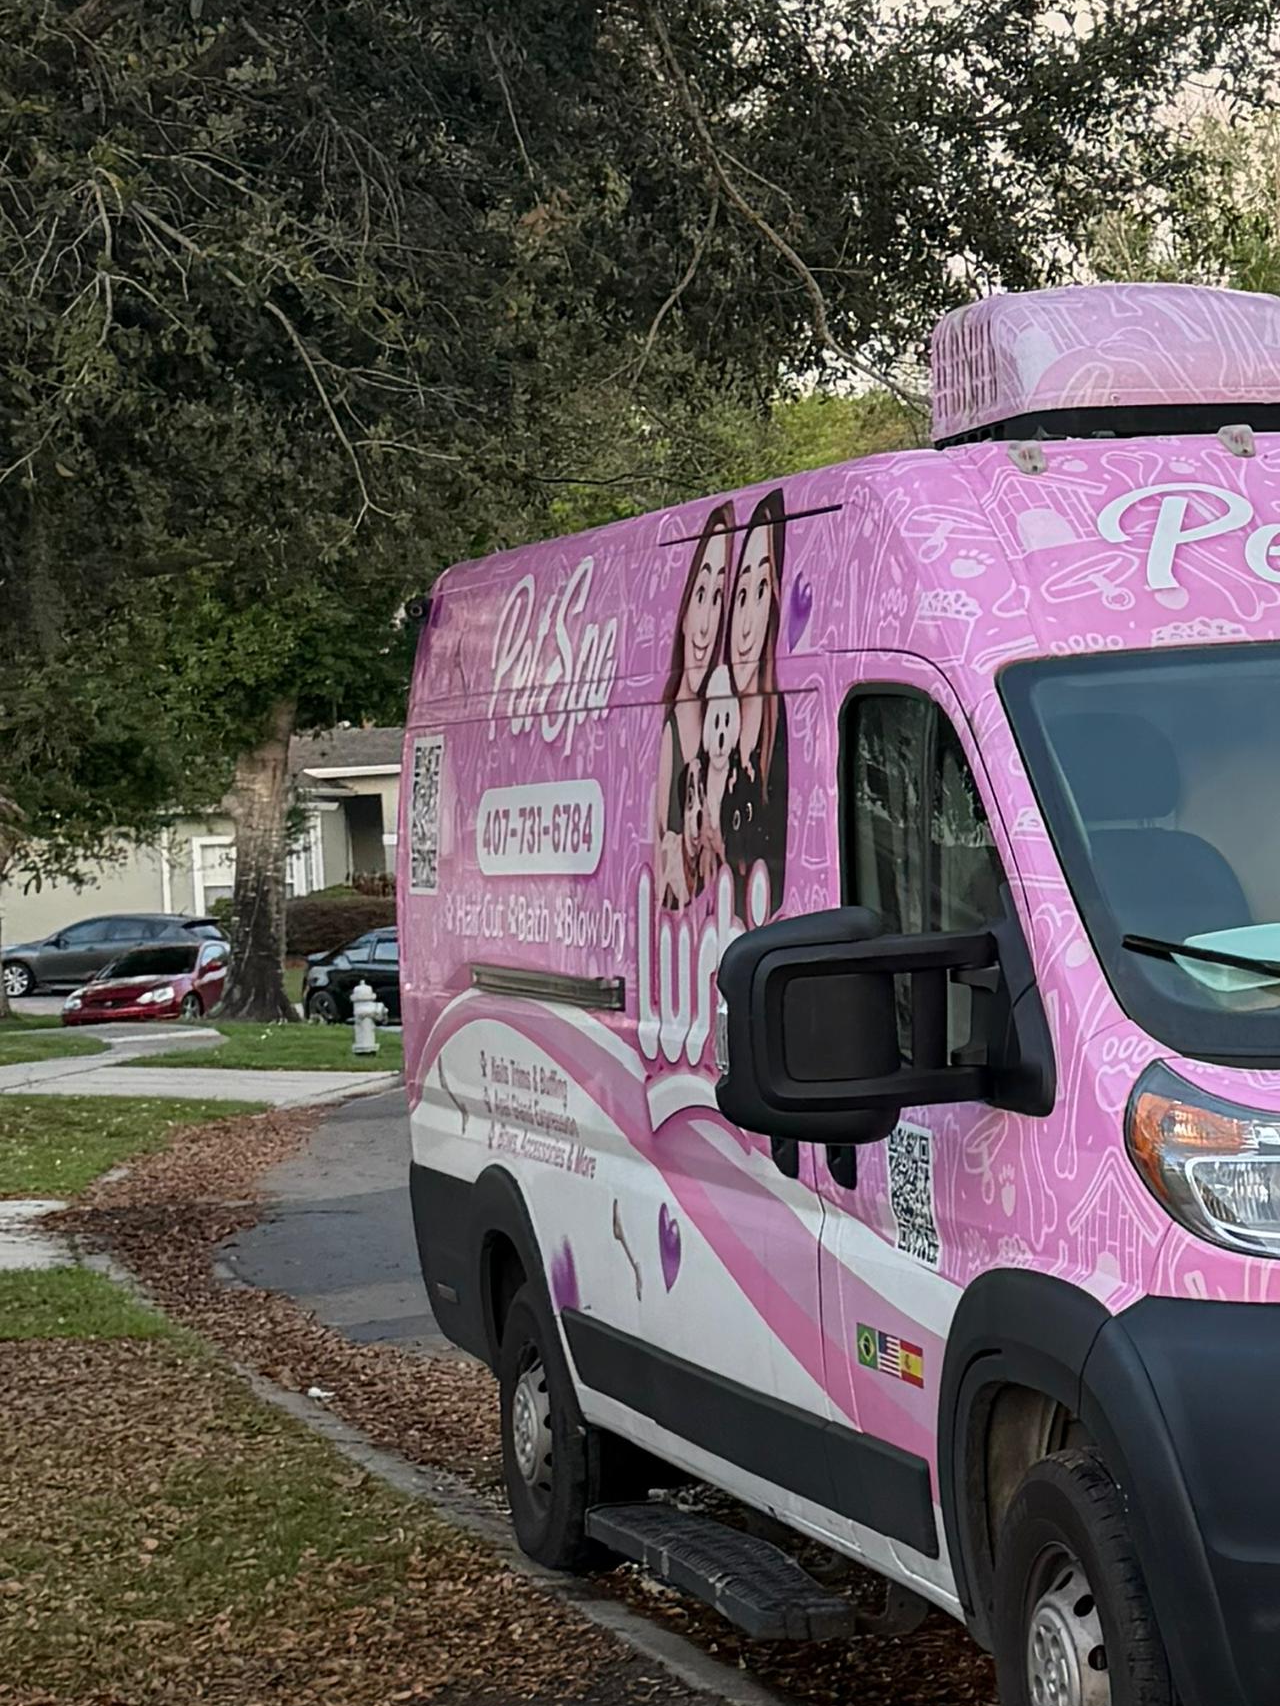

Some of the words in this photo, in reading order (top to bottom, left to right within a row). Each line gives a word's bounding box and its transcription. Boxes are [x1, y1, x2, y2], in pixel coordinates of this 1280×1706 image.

[488, 573, 557, 741] Pet
[541, 555, 618, 757] Spa
[483, 802, 593, 856] 407-731-6784
[518, 896, 550, 943] Bath
[564, 897, 600, 948] Blow
[601, 899, 627, 962] Dry
